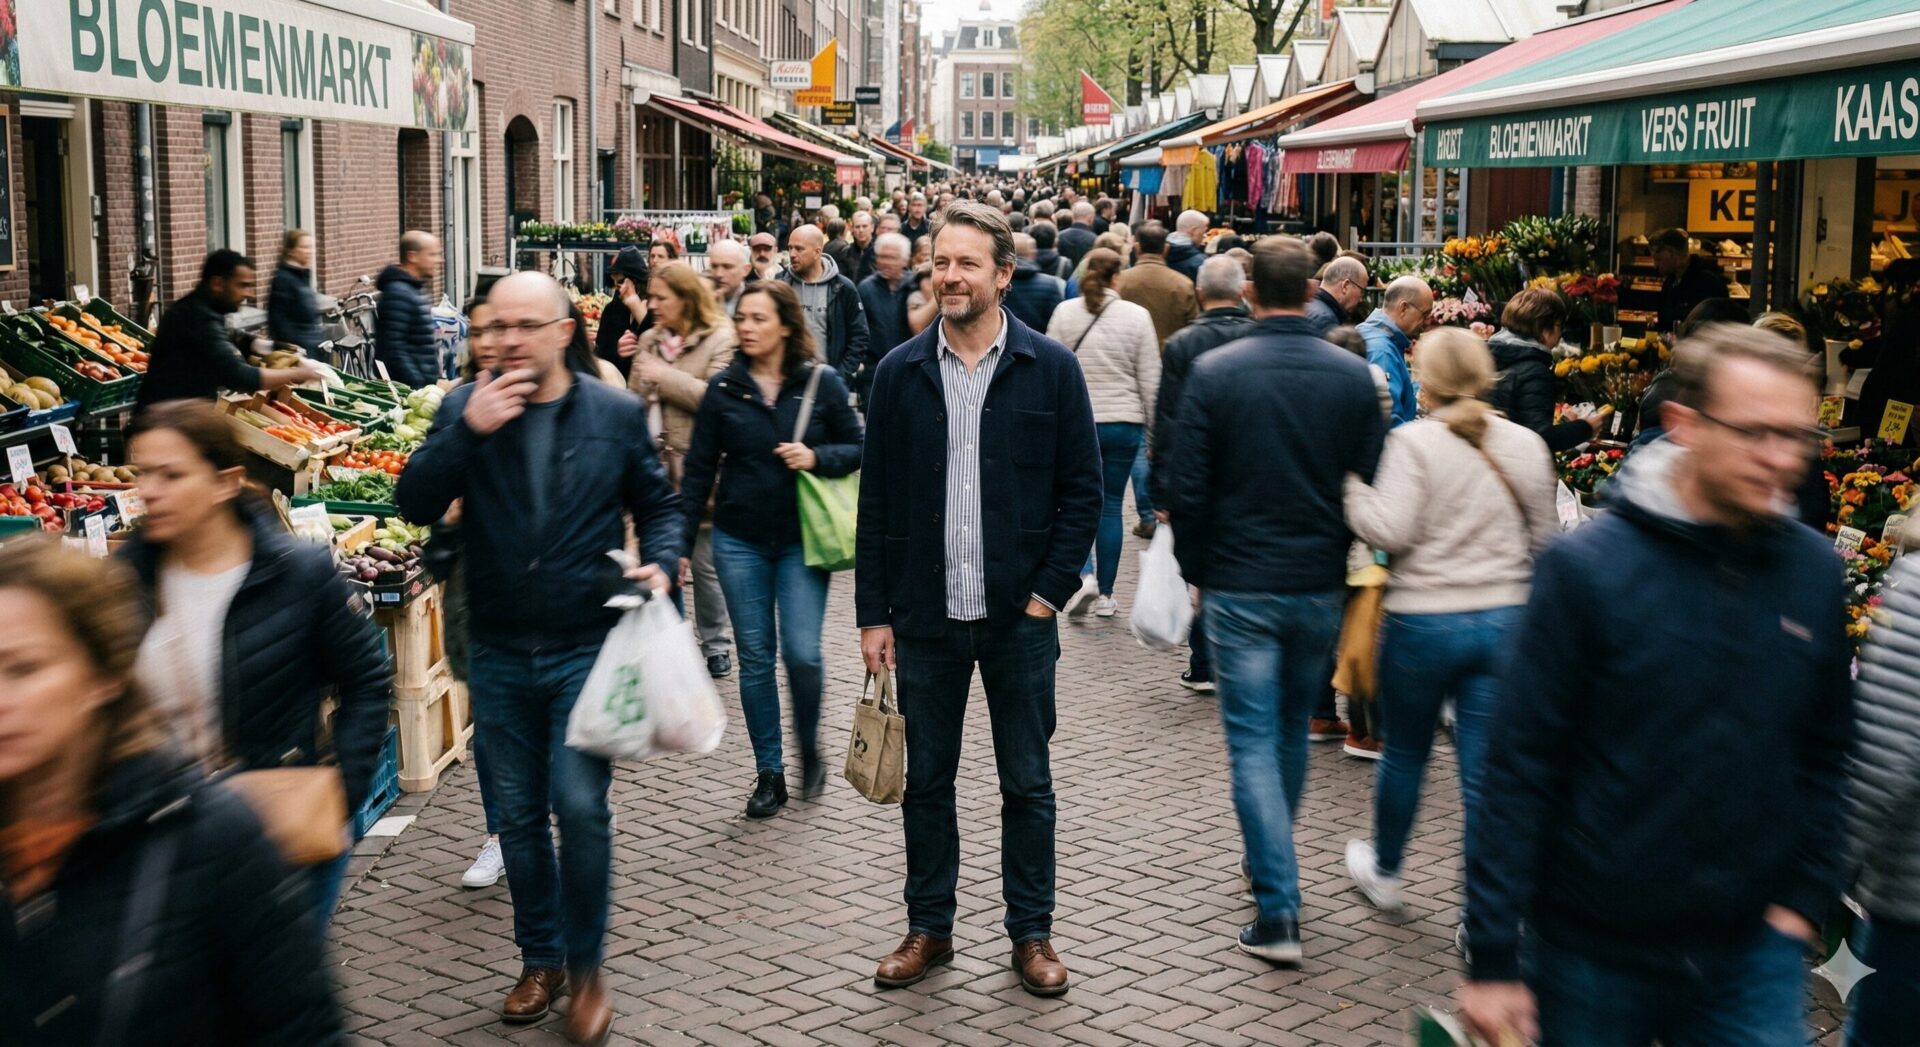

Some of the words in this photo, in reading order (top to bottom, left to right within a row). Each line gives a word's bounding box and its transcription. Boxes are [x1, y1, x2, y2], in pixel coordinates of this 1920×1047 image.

[70, 0, 391, 109] BLOEMENMARKT
[1489, 115, 1592, 159] BLOEMENMARKT
[1642, 104, 1689, 153] VERS
[1693, 97, 1757, 150] FRUIT
[1834, 77, 1919, 142] KAAS
